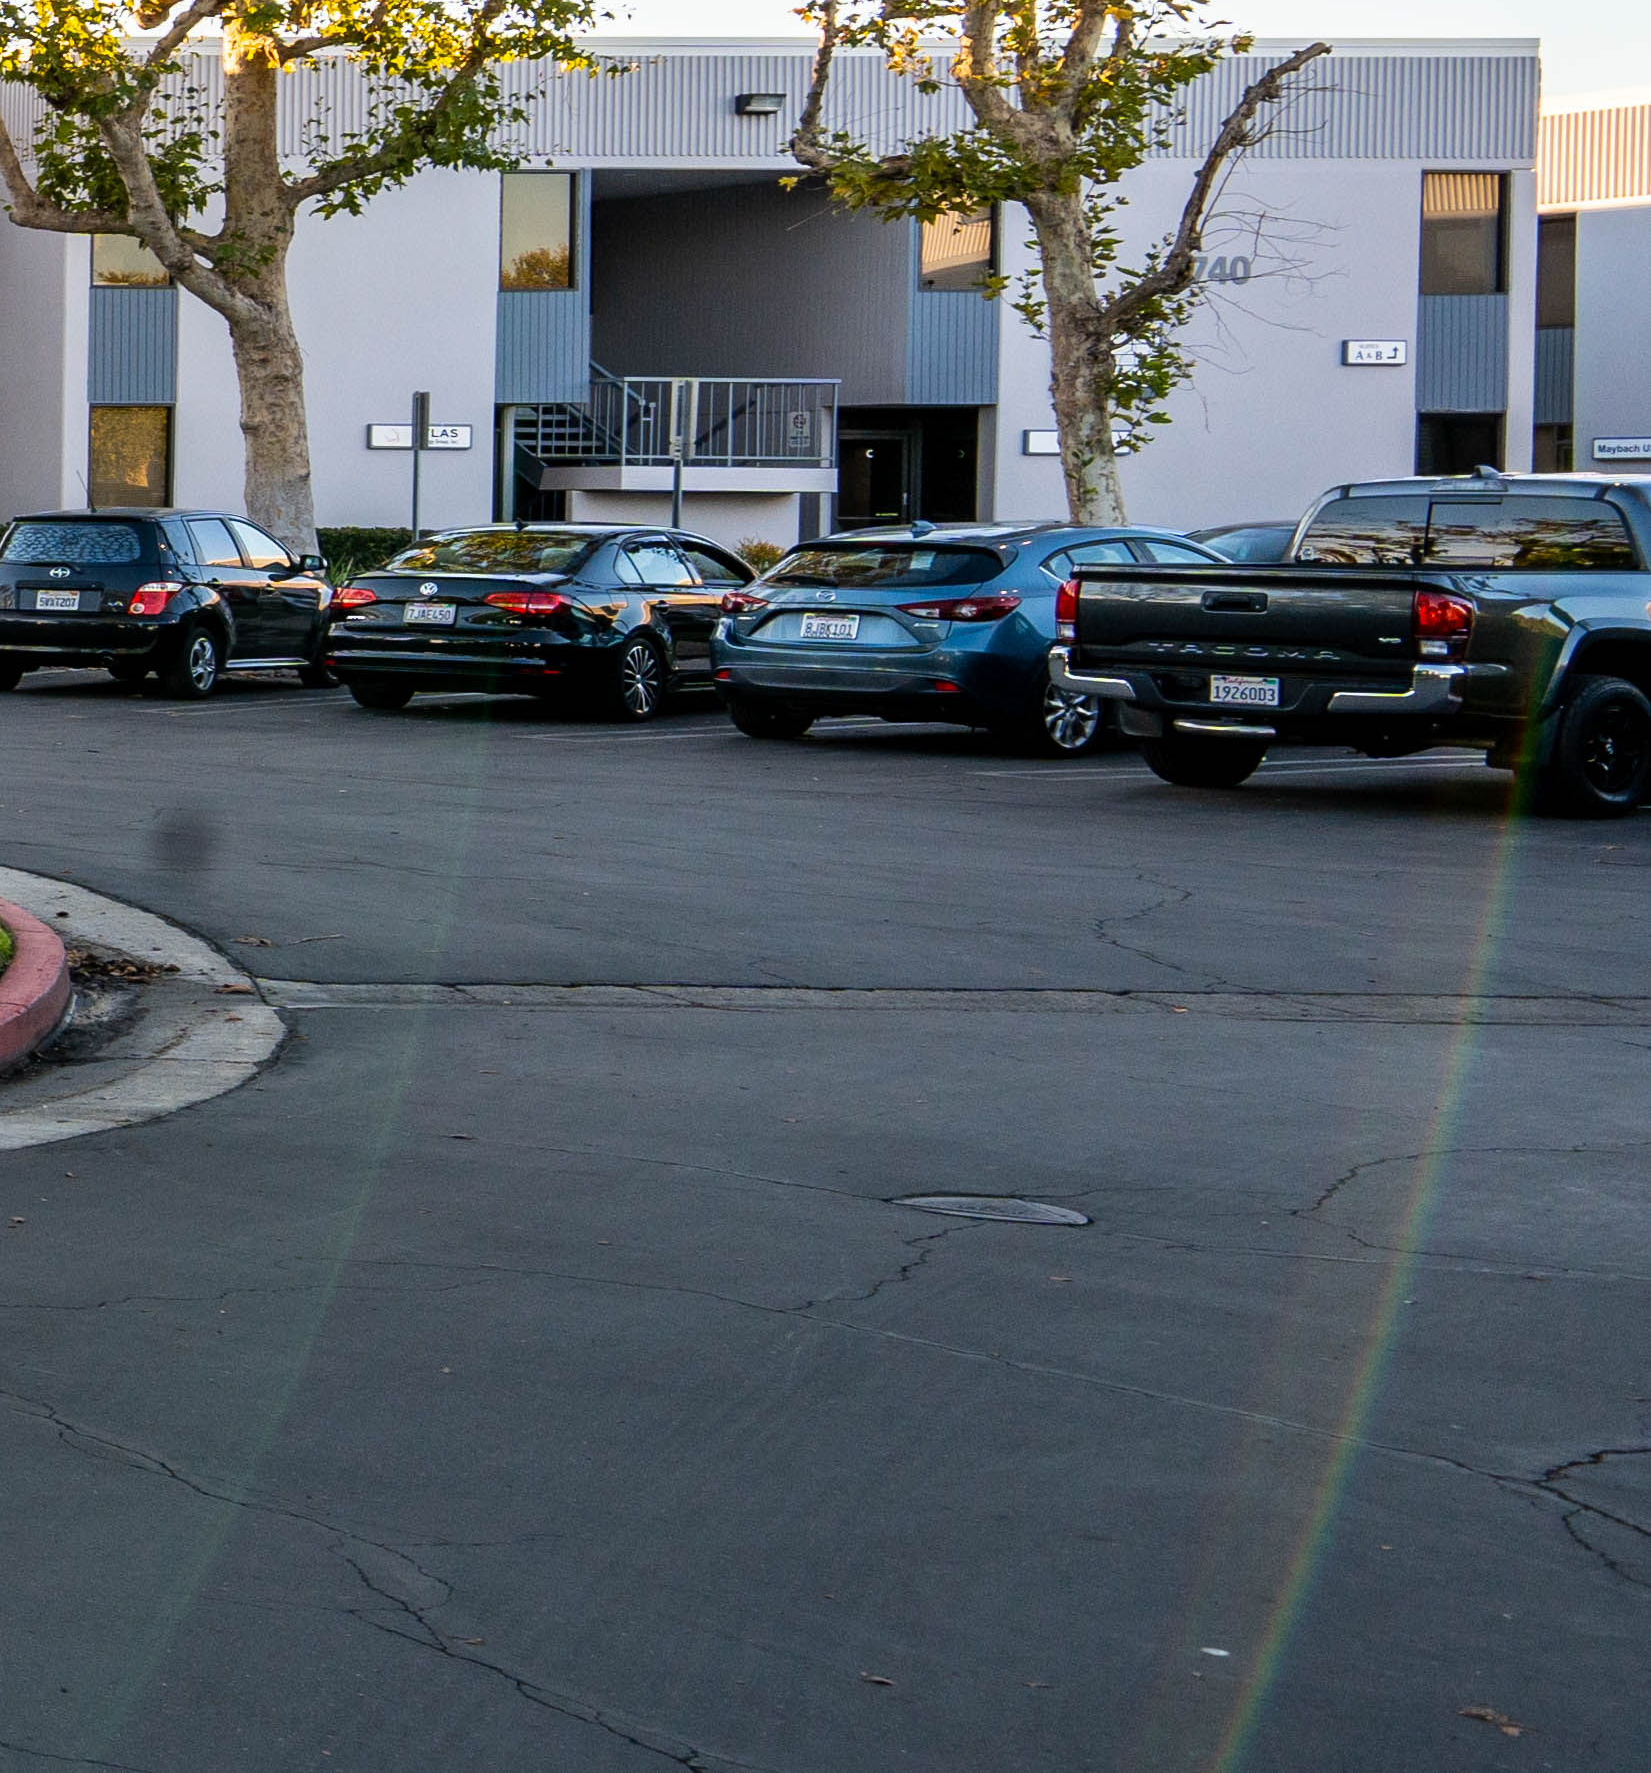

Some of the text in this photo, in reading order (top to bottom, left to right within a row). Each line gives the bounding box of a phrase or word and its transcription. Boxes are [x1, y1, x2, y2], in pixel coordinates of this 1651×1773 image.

[1194, 255, 1250, 285] 740
[1355, 350, 1364, 360] A
[1375, 350, 1383, 360] B
[430, 428, 458, 438] LAS
[1597, 444, 1640, 454] Maybach
[1148, 642, 1341, 660] TACOMA
[1213, 685, 1276, 703] 19260D3
